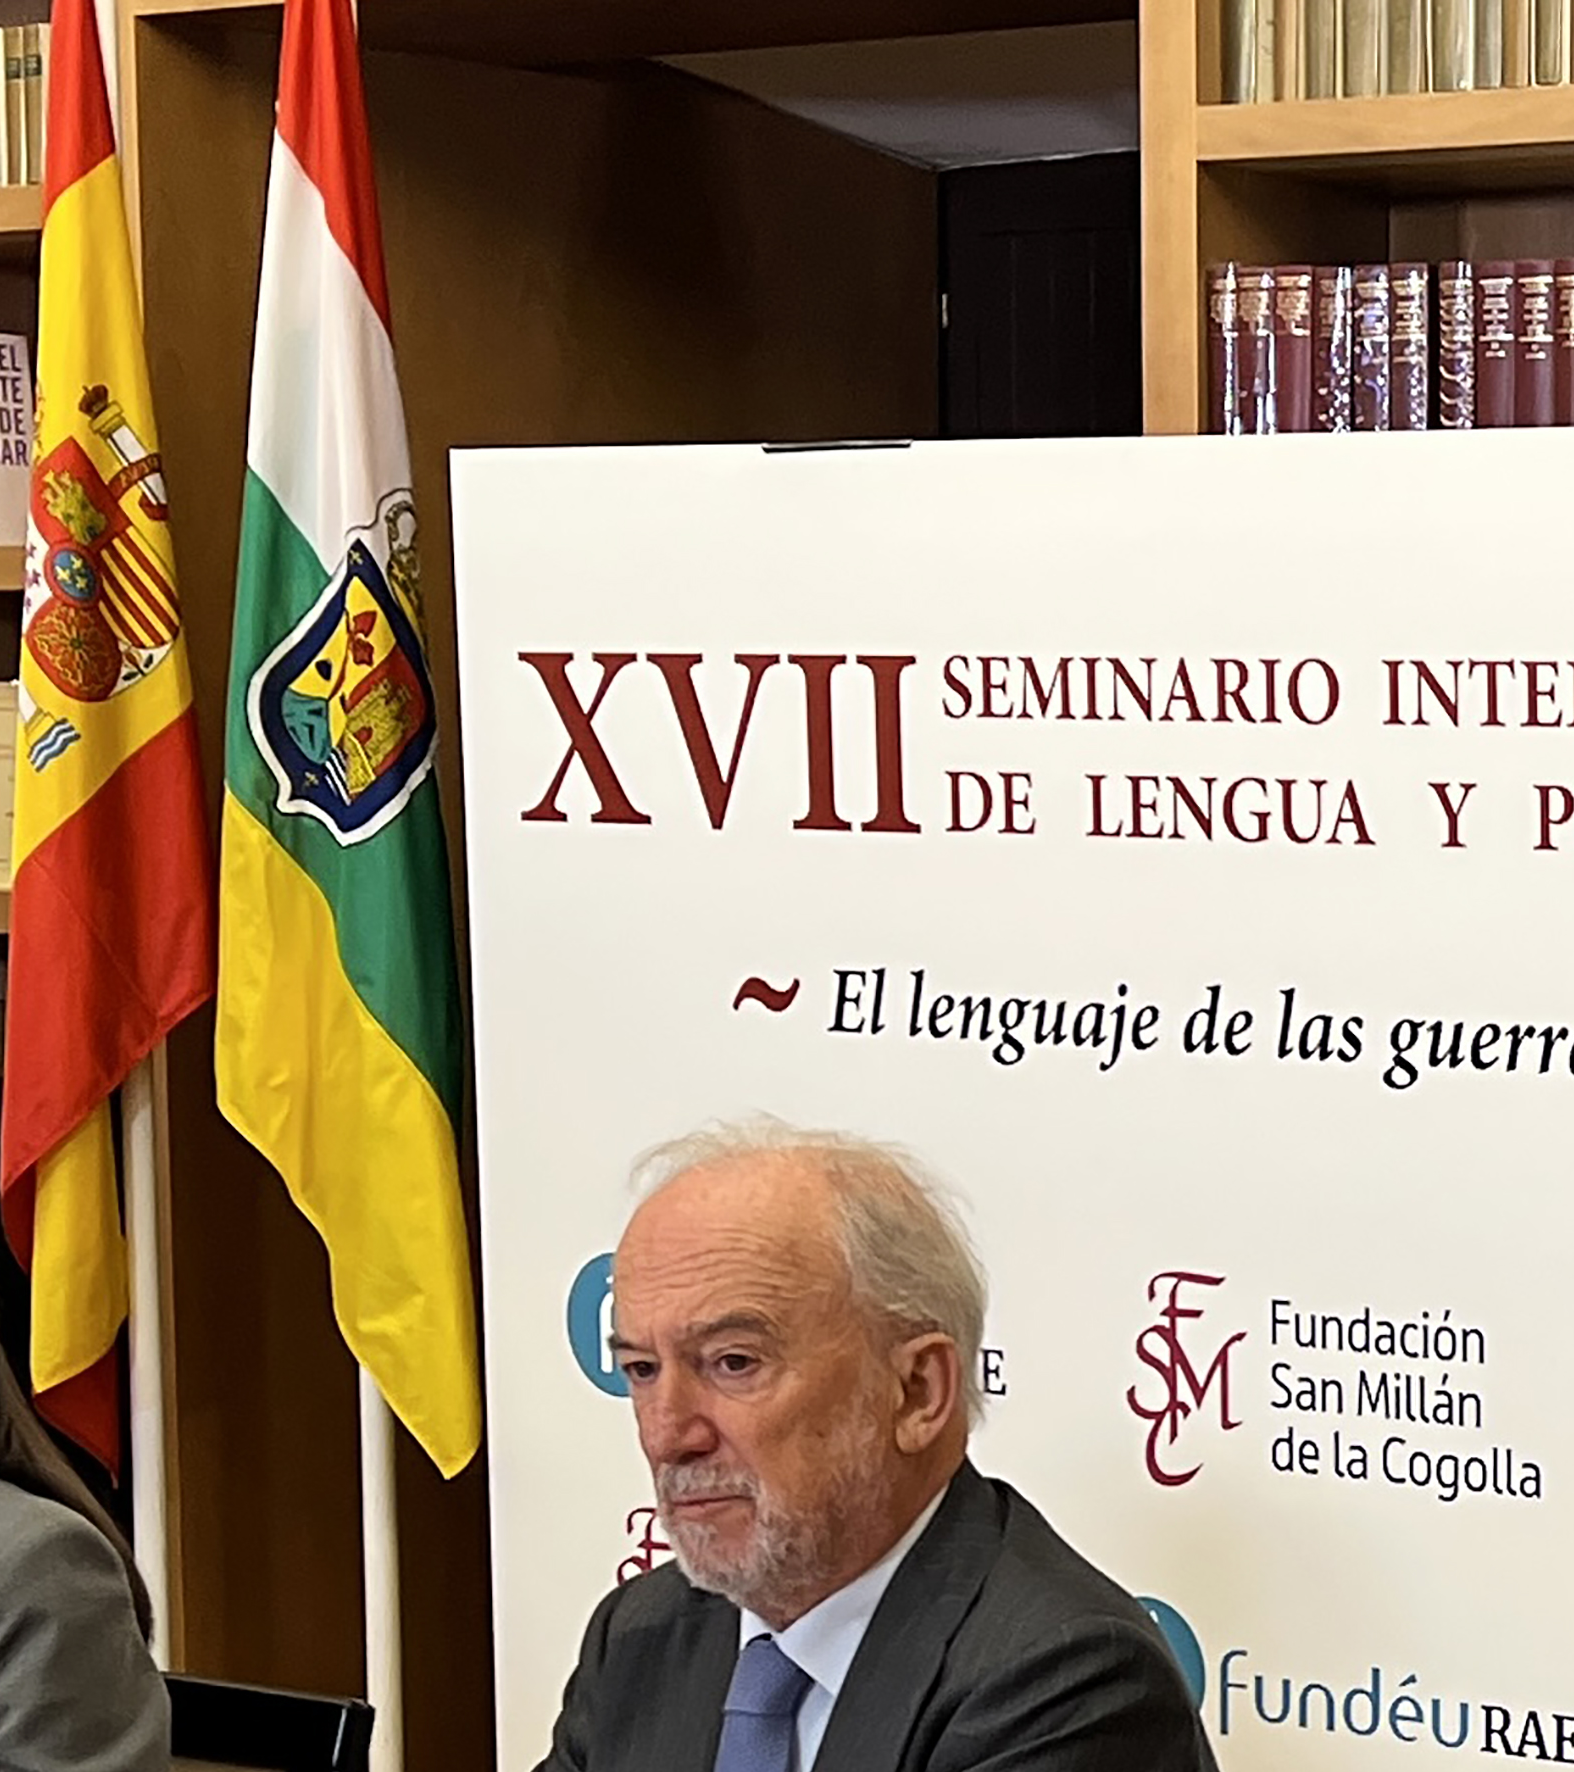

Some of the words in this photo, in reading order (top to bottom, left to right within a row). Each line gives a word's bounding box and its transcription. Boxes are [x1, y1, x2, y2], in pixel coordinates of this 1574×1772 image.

[0, 407, 25, 434] DE
[942, 655, 1339, 725] SEMINARIO
[518, 652, 921, 834] XVII
[945, 771, 1036, 834] DE
[1086, 774, 1375, 845] LENGUA
[1428, 783, 1477, 847] Y
[828, 968, 885, 1034] El
[910, 969, 1159, 1071] lenguaje
[1184, 985, 1253, 1056] de
[1278, 988, 1363, 1062] las
[1272, 1300, 1484, 1364] Fundación
[1271, 1363, 1343, 1414] San
[1357, 1370, 1481, 1427] Millán
[1272, 1427, 1319, 1475] de
[1334, 1431, 1367, 1479] la
[1383, 1437, 1541, 1502] Cogolla
